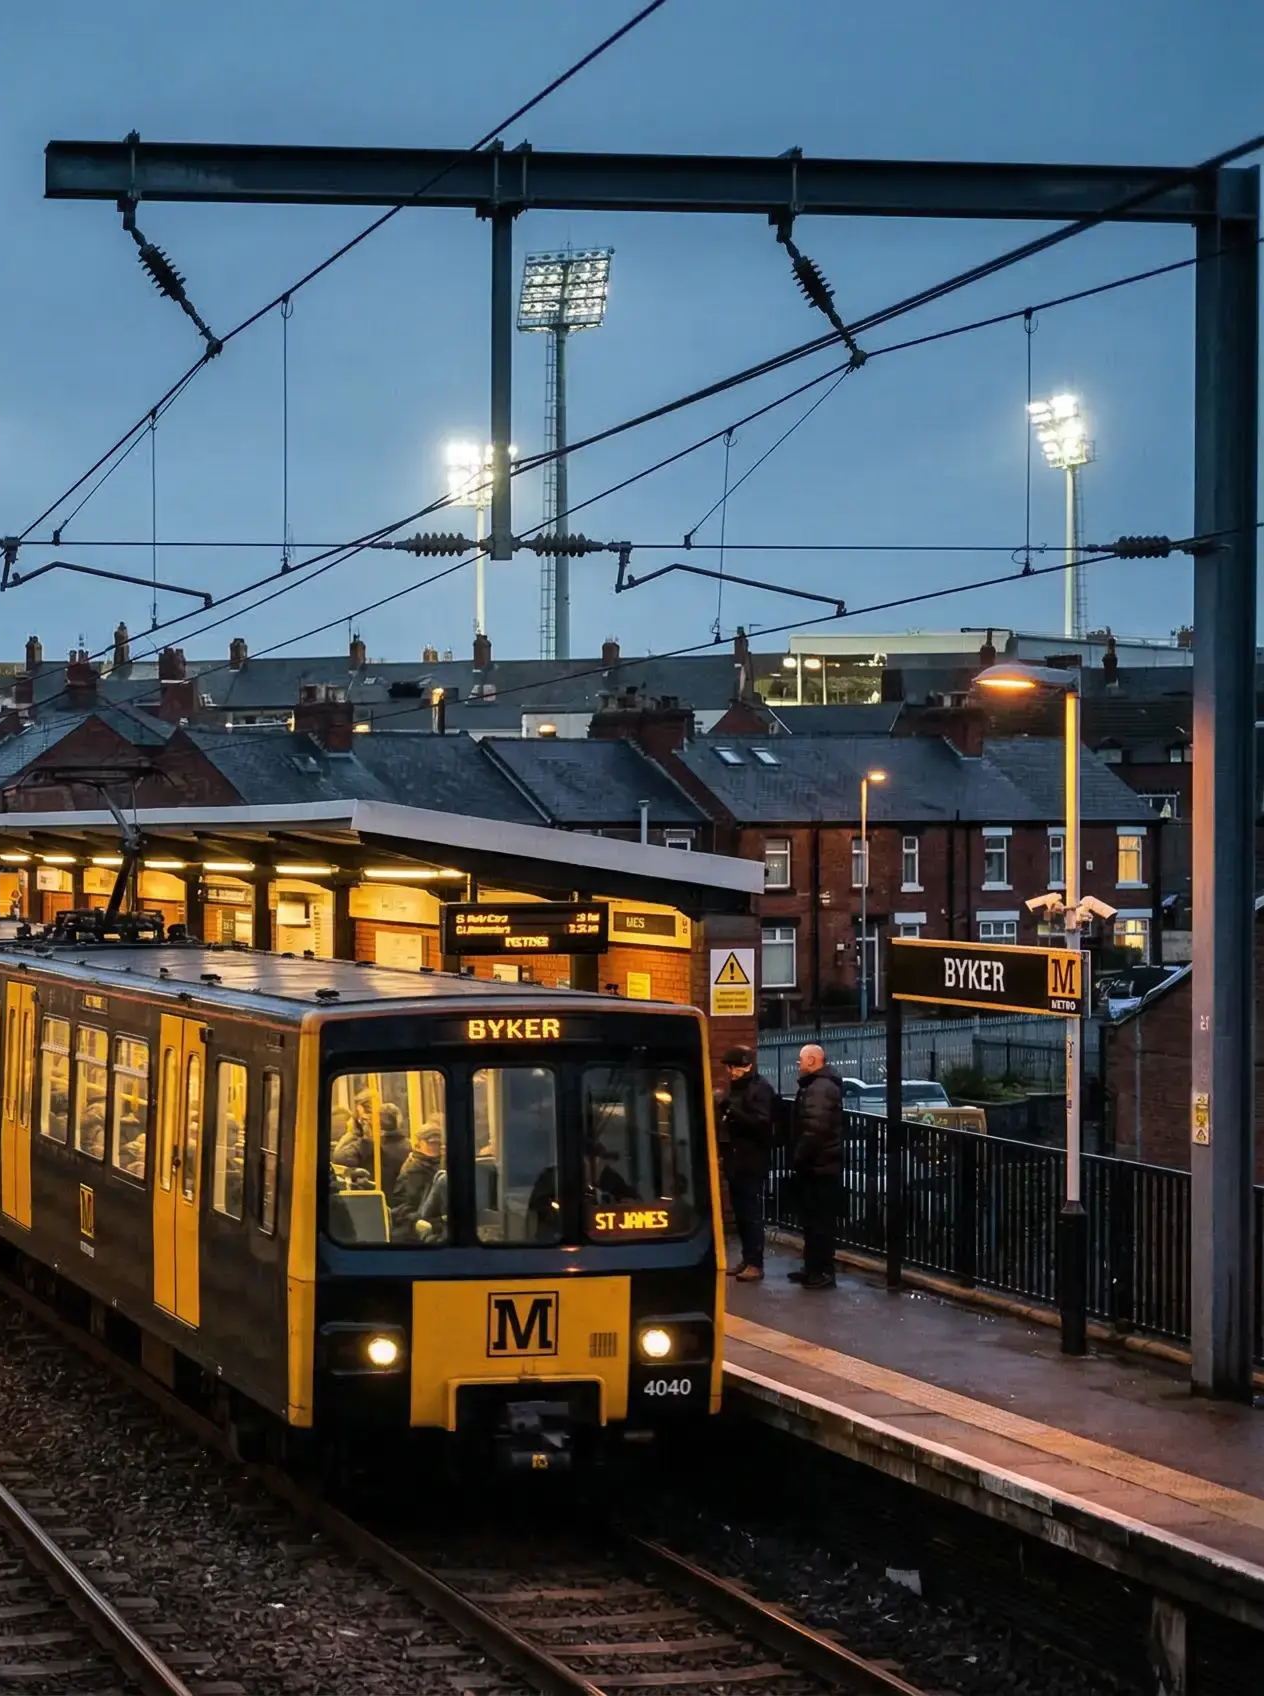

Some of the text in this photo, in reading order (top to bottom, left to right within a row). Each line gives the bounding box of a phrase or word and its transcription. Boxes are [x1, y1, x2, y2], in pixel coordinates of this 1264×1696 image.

[944, 957, 1005, 992] BYKER
[1051, 959, 1076, 994] M
[1051, 999, 1076, 1011] METRO
[468, 1018, 560, 1039] BYKER
[595, 1212, 616, 1230] ST
[493, 1298, 553, 1350] M
[643, 1378, 692, 1396] 4040
